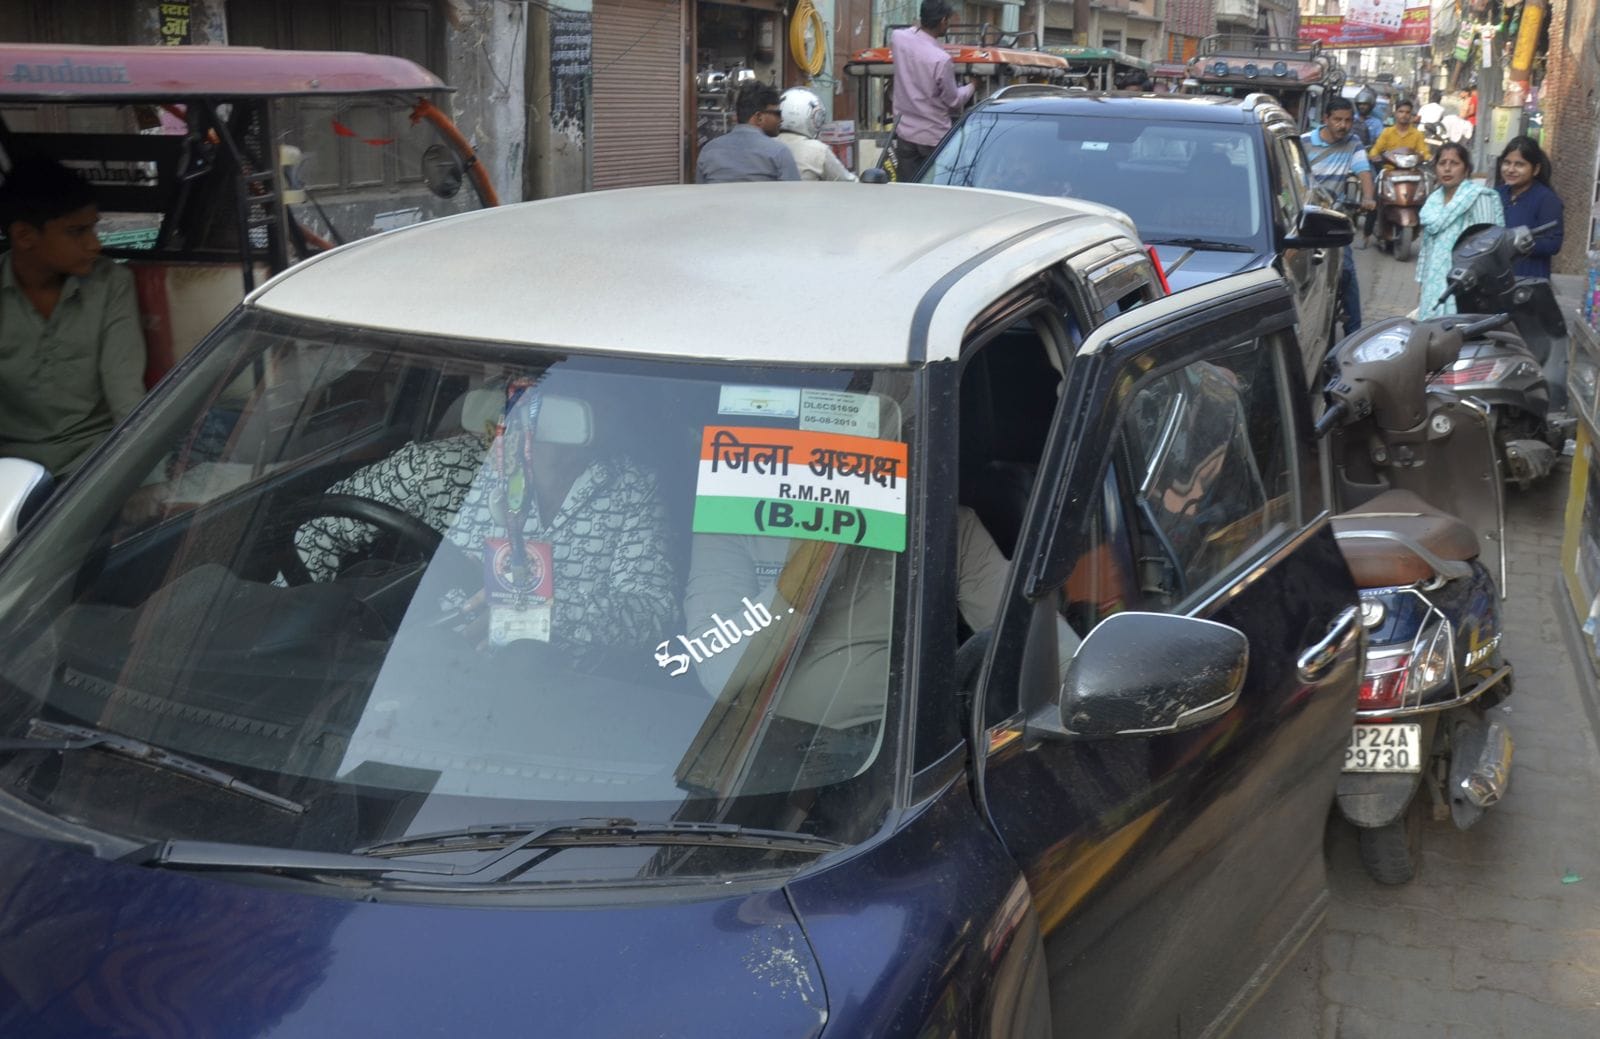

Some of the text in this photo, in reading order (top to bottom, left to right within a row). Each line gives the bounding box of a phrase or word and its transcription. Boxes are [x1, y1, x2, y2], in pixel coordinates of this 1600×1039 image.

[710, 430, 901, 490] जिला अध्यक्ष
[778, 483, 850, 505] R.M.P.M
[753, 499, 868, 544] (B.J.P)
